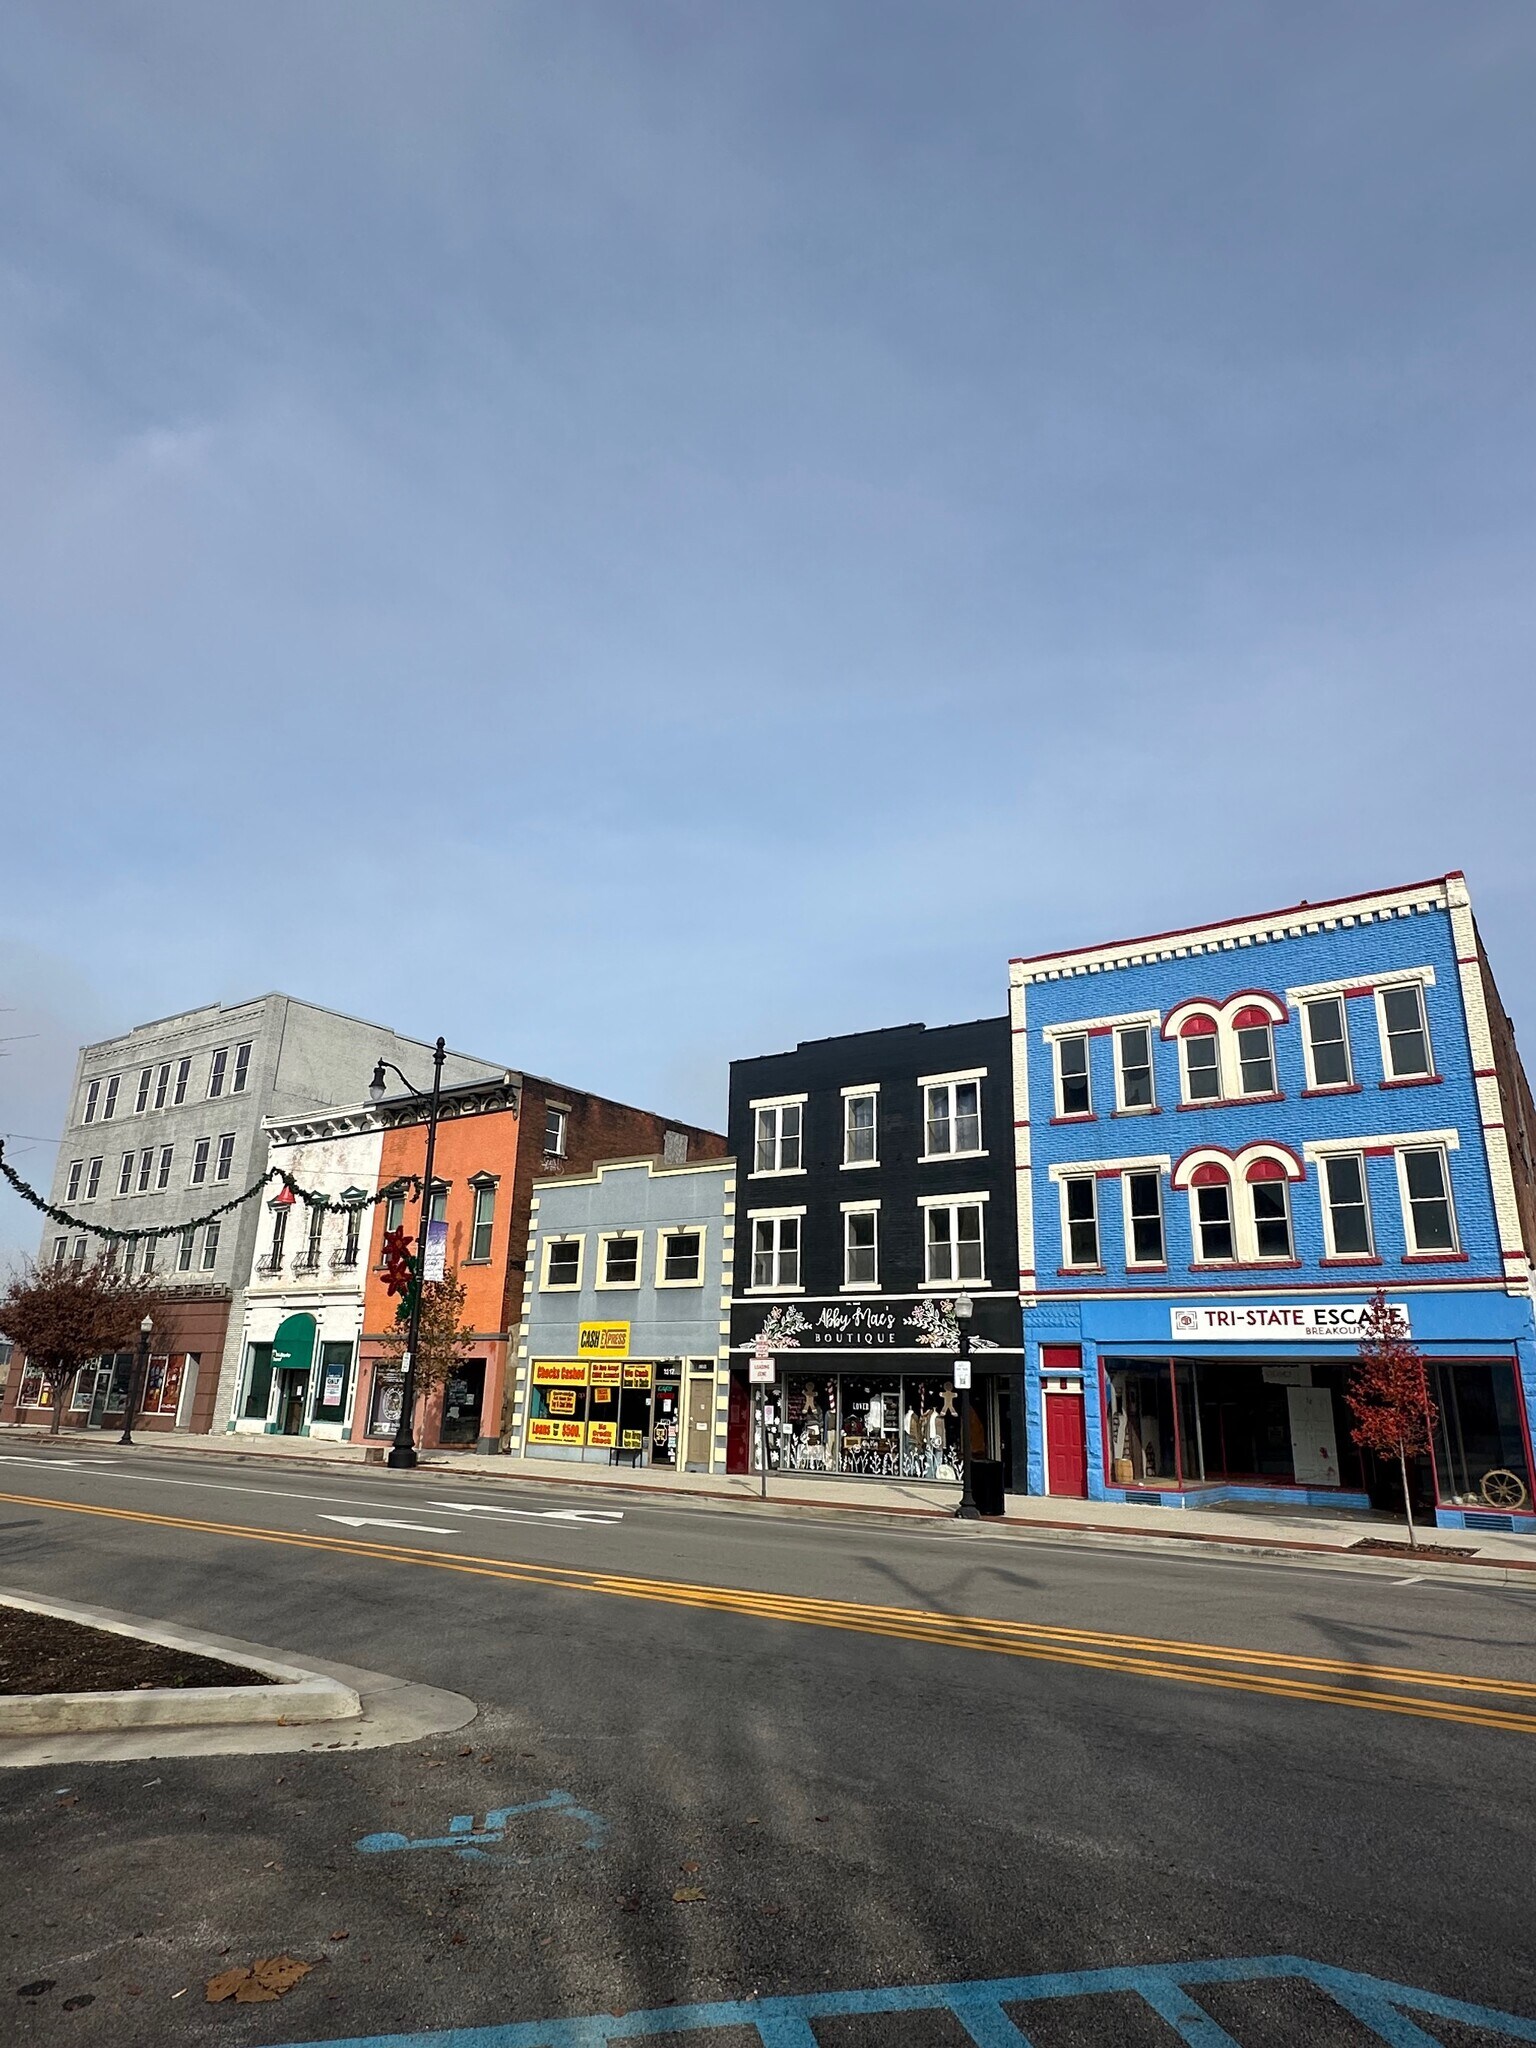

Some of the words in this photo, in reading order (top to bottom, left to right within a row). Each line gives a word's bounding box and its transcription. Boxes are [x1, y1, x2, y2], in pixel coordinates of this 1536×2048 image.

[815, 1307, 851, 1331] Abby
[852, 1305, 896, 1329] Mae's
[1204, 1309, 1305, 1326] TRI-STATE
[1314, 1308, 1403, 1326] ESCAPE
[815, 1333, 896, 1344] BOUTIQUE
[1306, 1327, 1363, 1335] BREAKOUT
[580, 1329, 600, 1348] CASH
[600, 1329, 627, 1349] EXPRESS
[537, 1366, 560, 1379] Checks
[561, 1366, 585, 1380] Cashed
[532, 1421, 551, 1436] Loans
